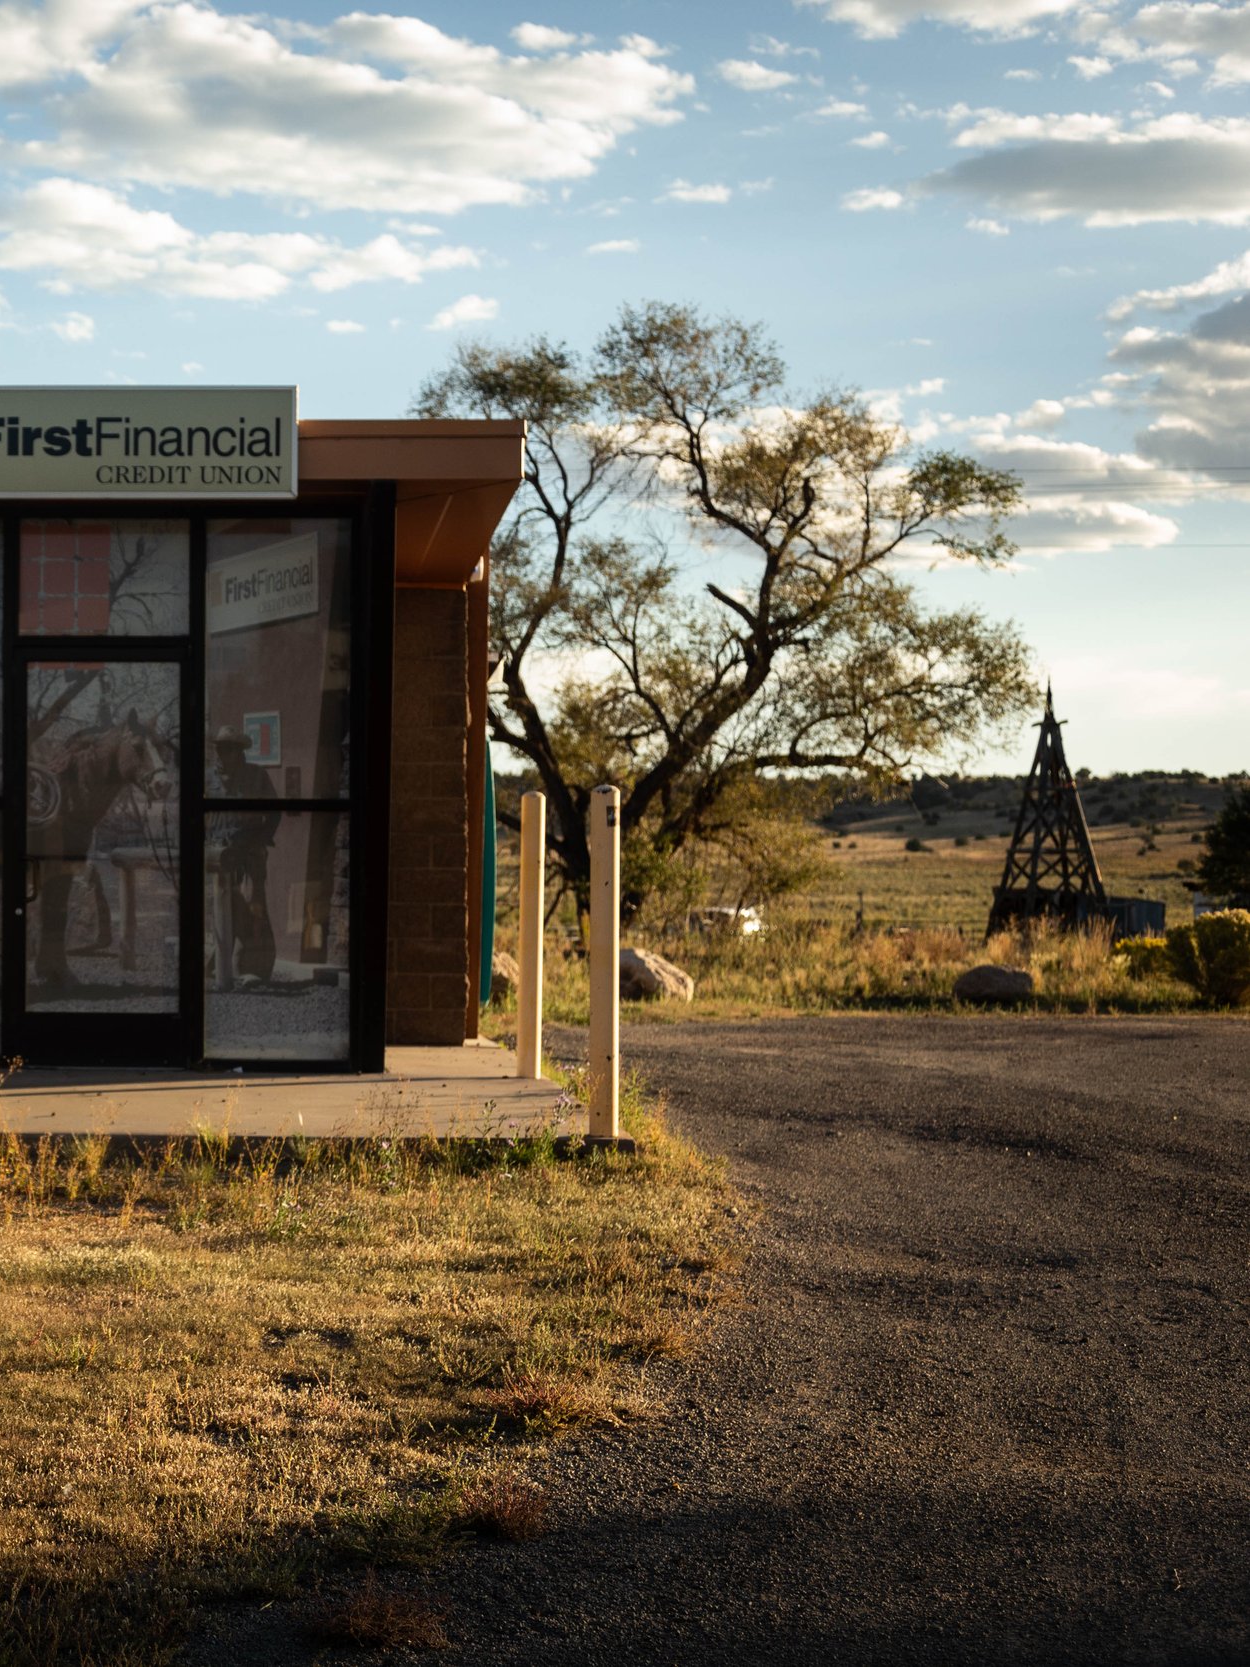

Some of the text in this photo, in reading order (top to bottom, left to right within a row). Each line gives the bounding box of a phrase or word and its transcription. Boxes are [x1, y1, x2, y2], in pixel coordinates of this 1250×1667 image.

[96, 465, 282, 485] CREDIT UNION
[225, 556, 313, 604] FirstFinancial
